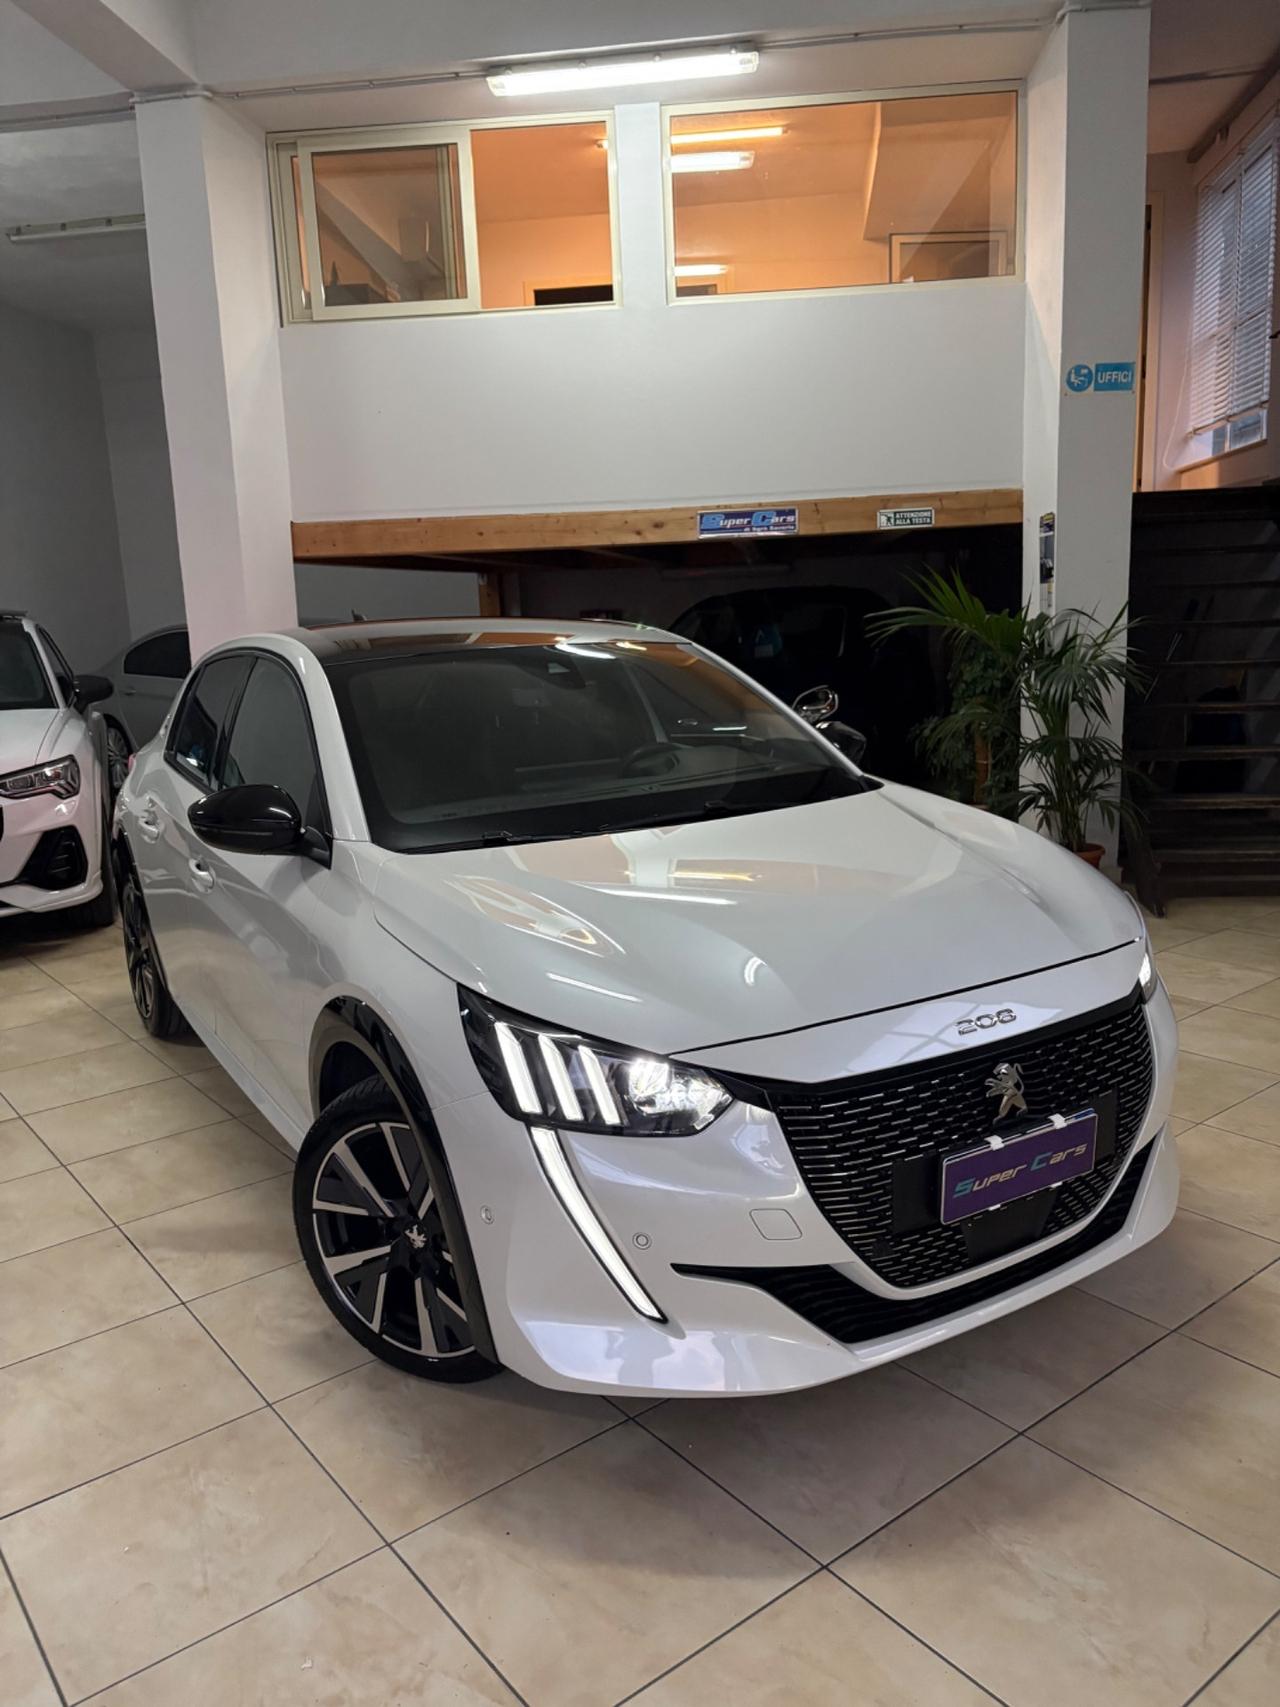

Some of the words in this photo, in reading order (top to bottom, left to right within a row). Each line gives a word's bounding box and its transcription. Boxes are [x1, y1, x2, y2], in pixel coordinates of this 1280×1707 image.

[1097, 371, 1133, 384] UFFICI
[701, 513, 752, 529] Super
[751, 511, 795, 527] Cars
[953, 1164, 1028, 1198] Super
[1030, 1143, 1088, 1171] Cars
